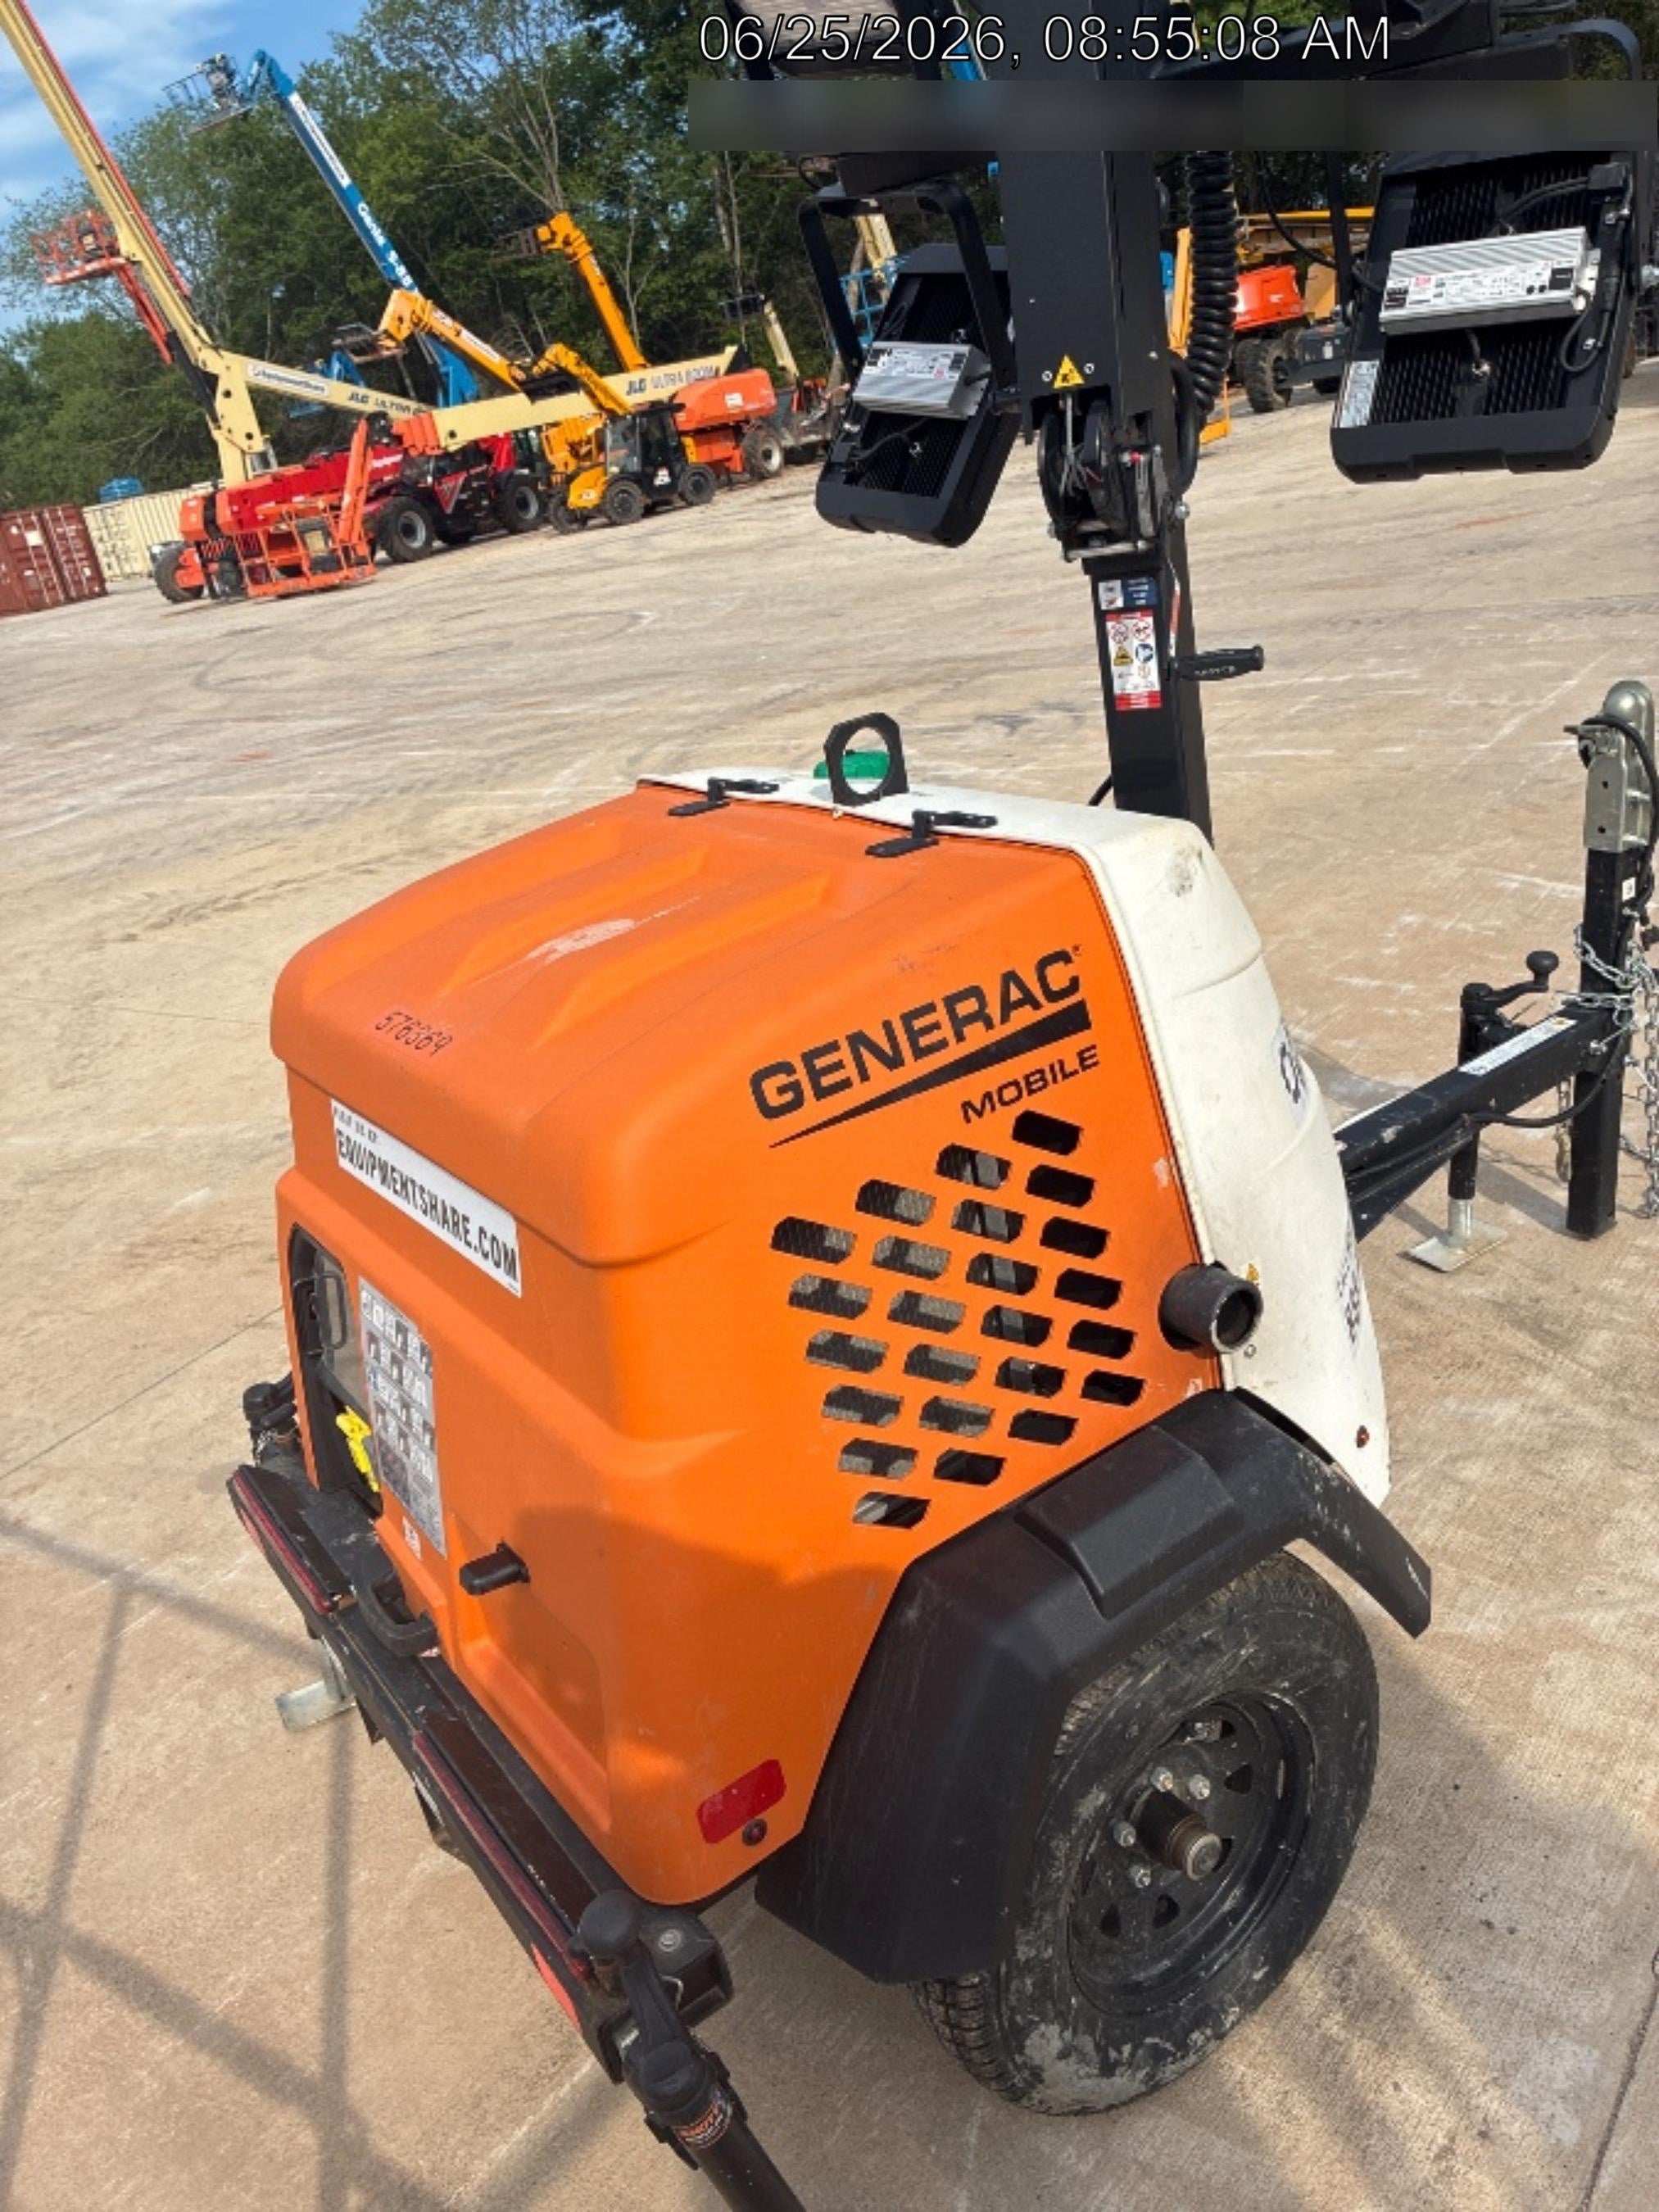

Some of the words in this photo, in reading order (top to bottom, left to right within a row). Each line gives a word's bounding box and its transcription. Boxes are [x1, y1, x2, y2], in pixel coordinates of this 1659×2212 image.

[749, 948, 1081, 1121] GENERAC
[960, 1045, 1099, 1124] MOBILE
[336, 1127, 519, 1283] EQUIPMENTSHARE.COM
